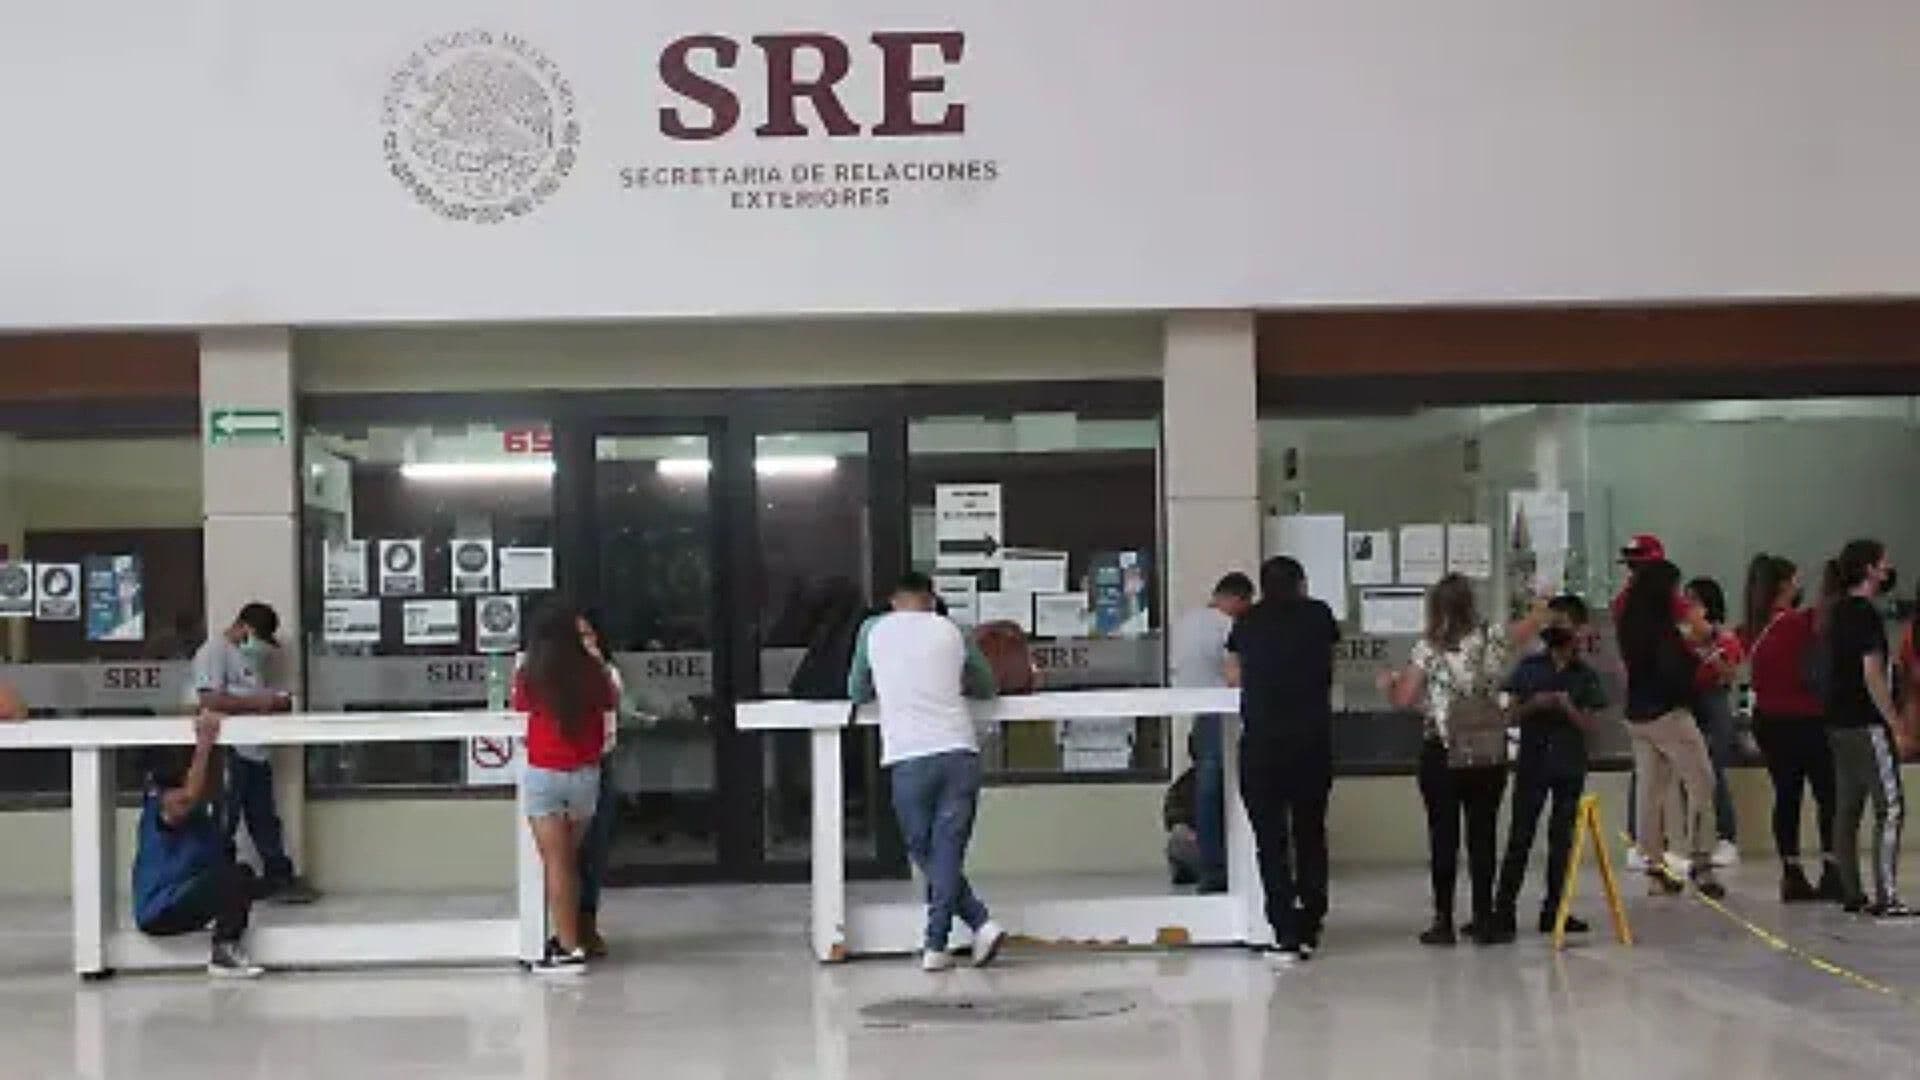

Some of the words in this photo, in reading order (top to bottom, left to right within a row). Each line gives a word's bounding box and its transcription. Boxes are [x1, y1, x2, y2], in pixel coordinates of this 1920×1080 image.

[658, 31, 966, 139] SRE
[619, 166, 782, 189] SECRETARIA
[791, 162, 826, 185] DE
[834, 159, 1000, 183] RELACIONES
[730, 186, 891, 210] EXTERIORES
[646, 655, 705, 678] SRE
[1031, 646, 1088, 669] SRE
[104, 666, 162, 690] SRE
